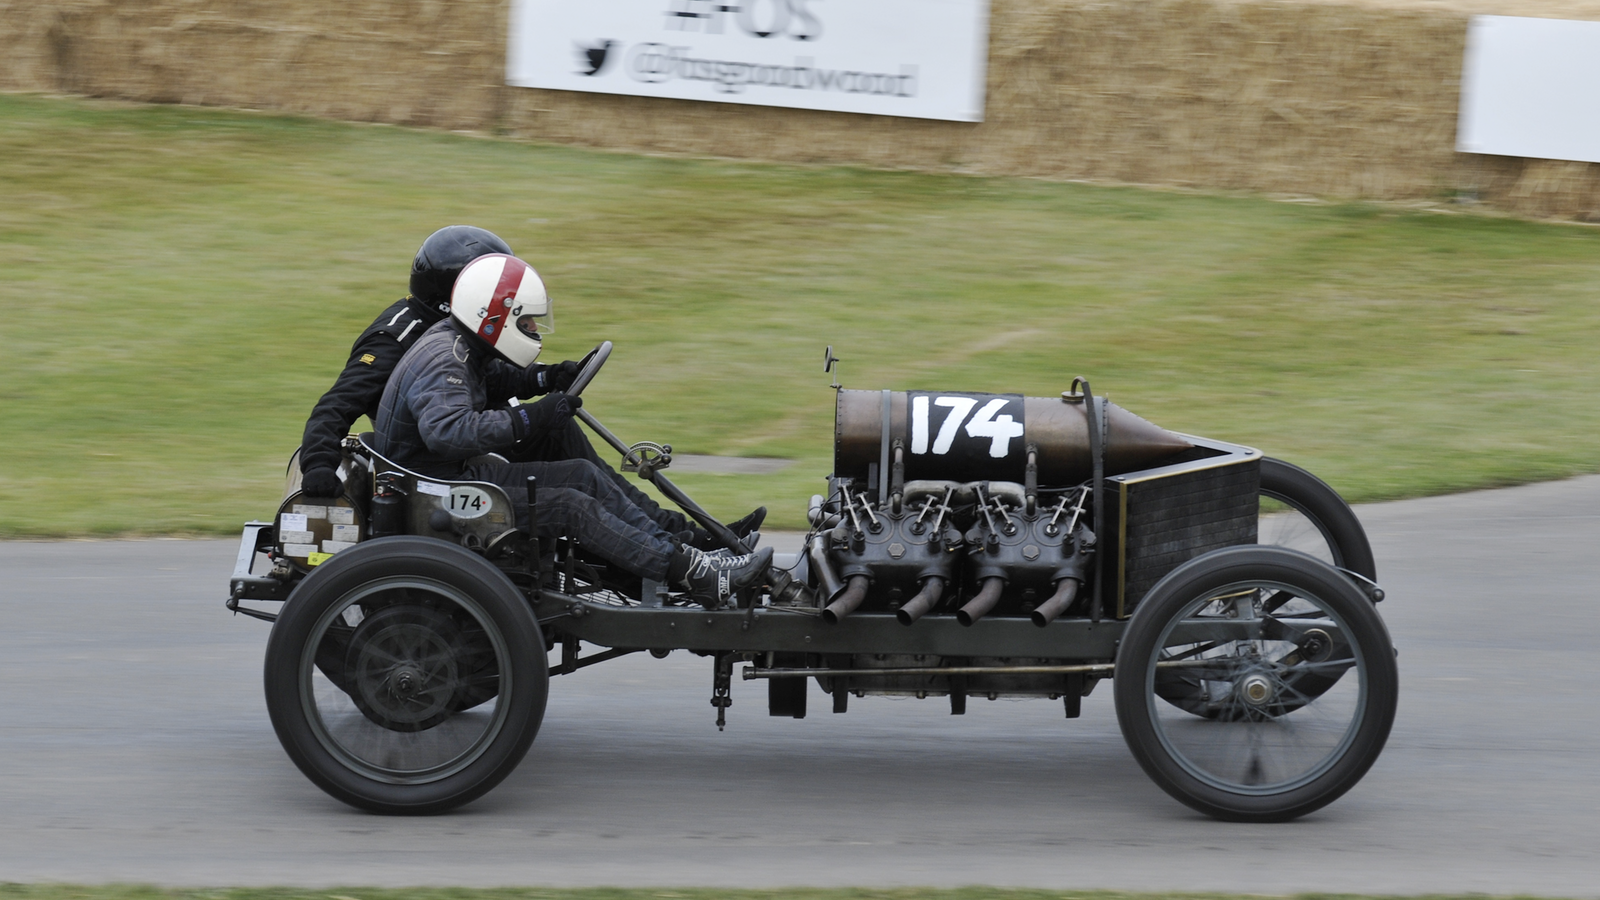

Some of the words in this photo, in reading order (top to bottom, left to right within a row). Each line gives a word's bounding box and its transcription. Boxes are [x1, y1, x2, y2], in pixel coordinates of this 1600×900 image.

[624, 42, 919, 98] @fosgoodwood
[911, 396, 1024, 458] 174
[450, 494, 482, 511] 174
[720, 576, 728, 595] OMP
